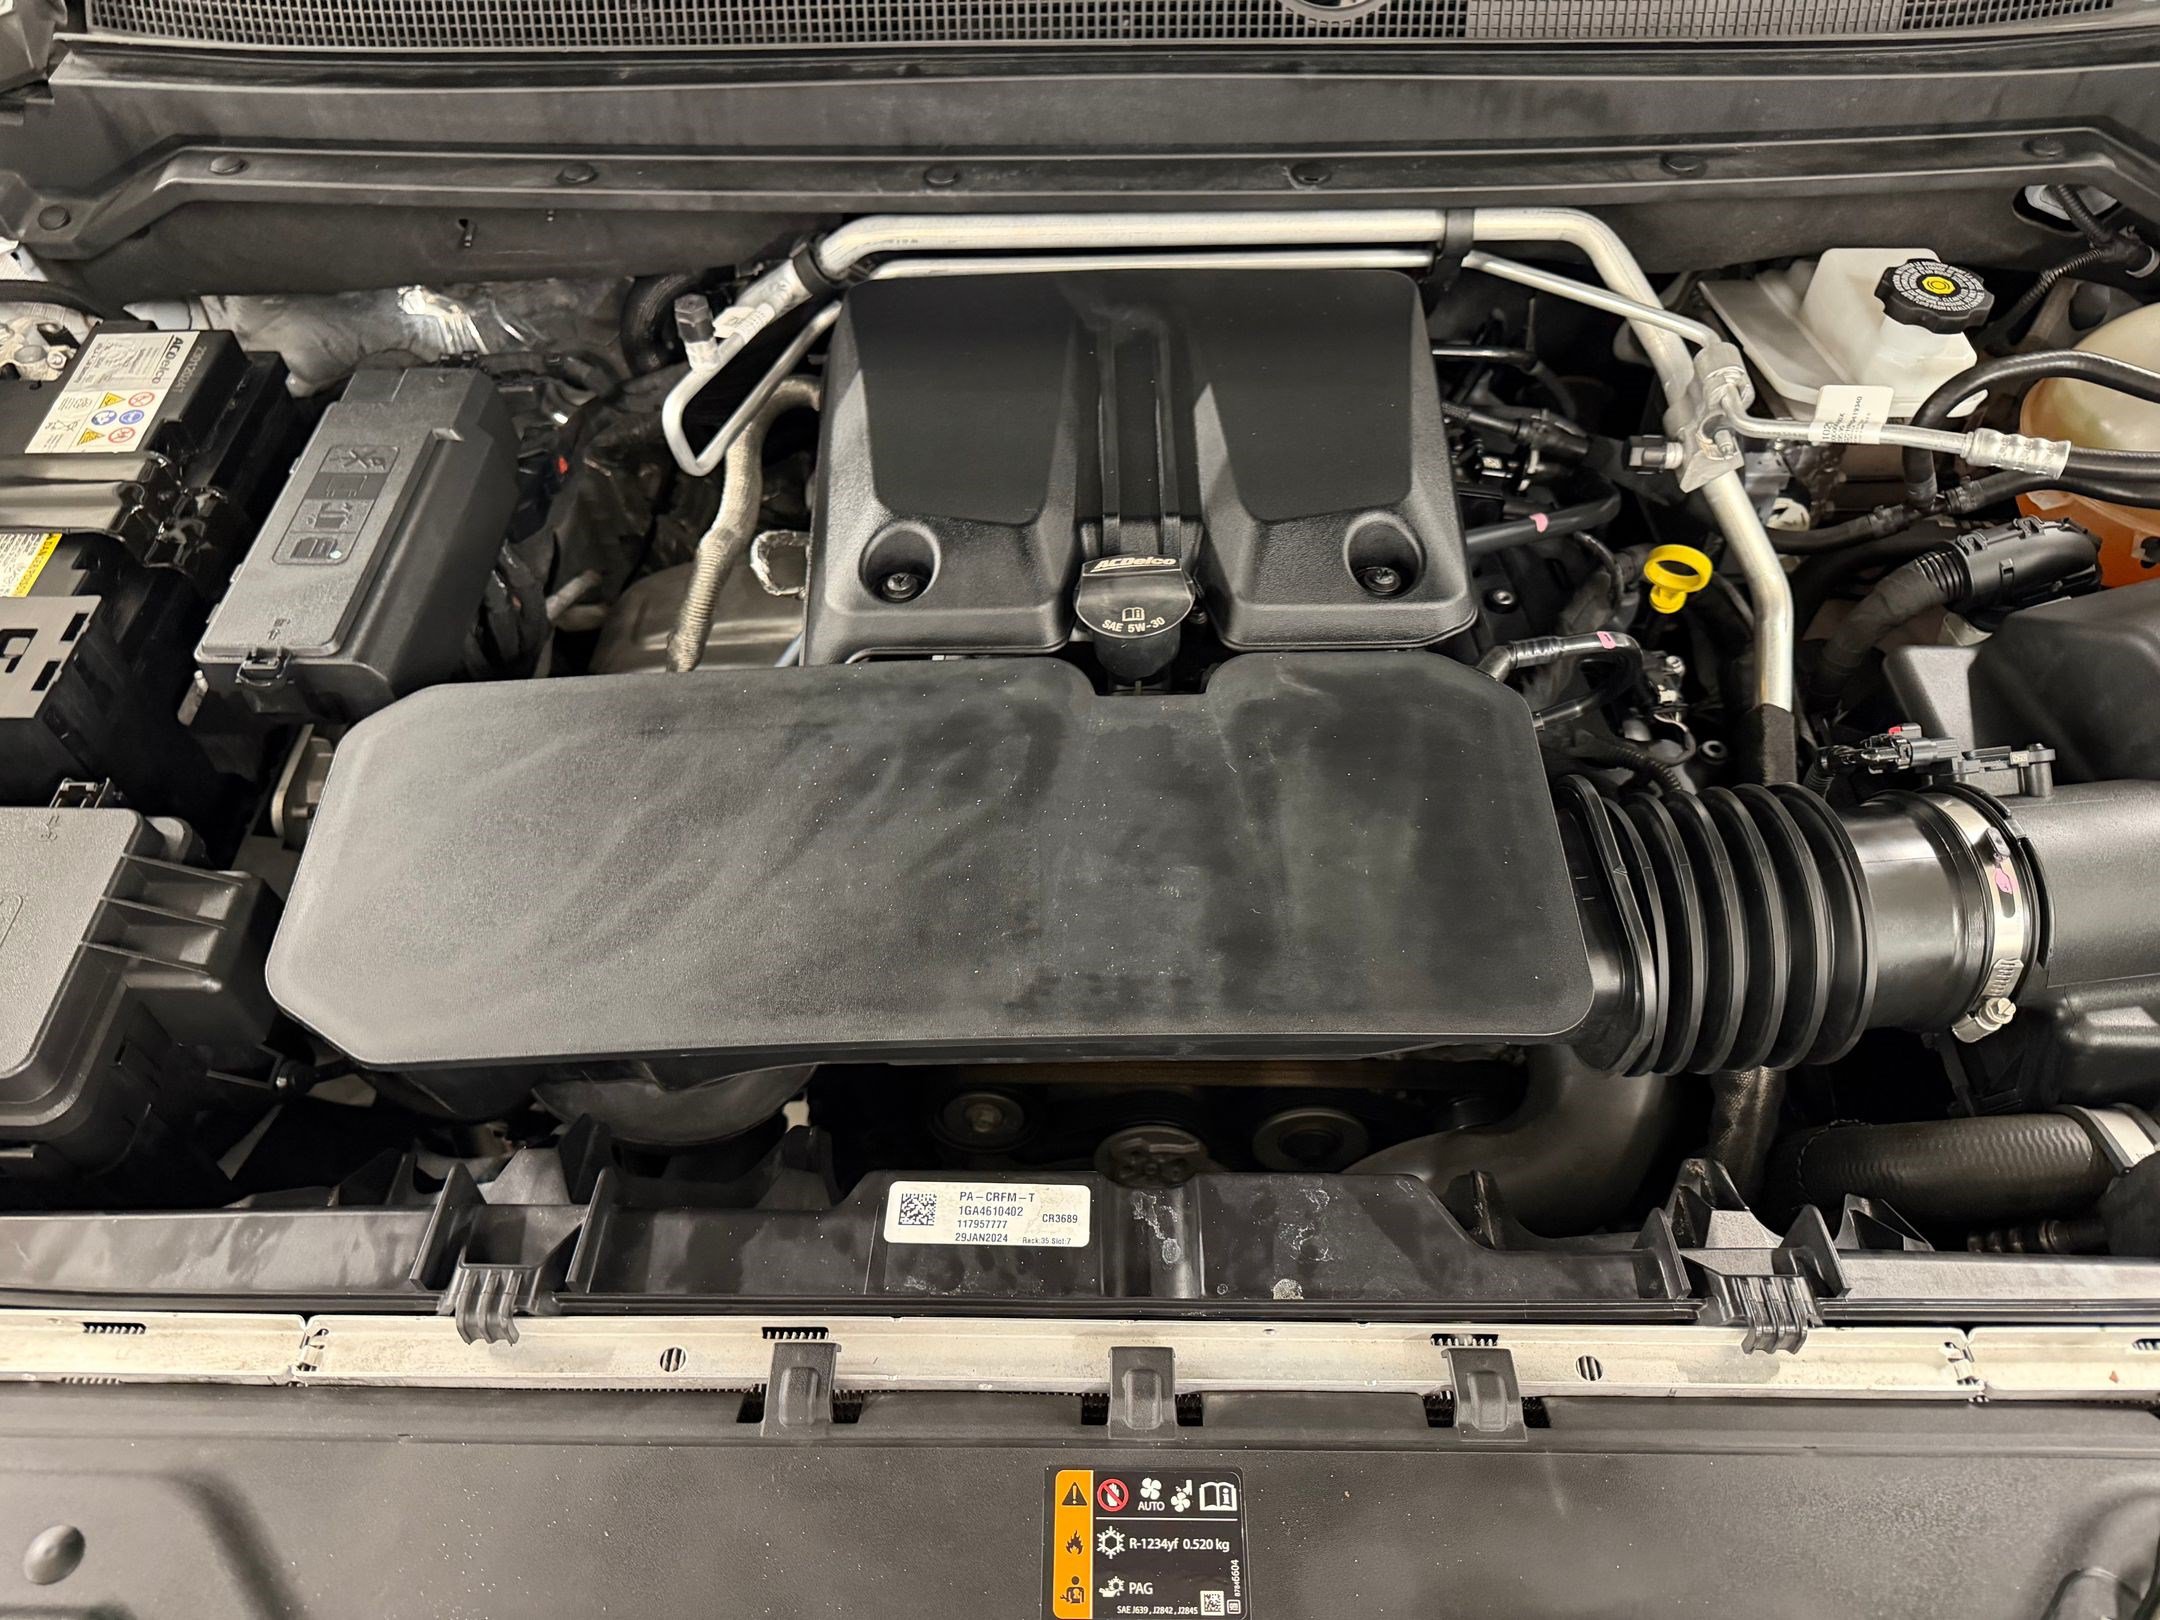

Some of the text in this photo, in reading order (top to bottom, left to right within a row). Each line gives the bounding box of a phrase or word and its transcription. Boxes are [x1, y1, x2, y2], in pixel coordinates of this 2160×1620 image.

[152, 336, 184, 384] ACDelco
[1093, 556, 1177, 569] ACDelco
[1102, 616, 1166, 633] SAE 5W-30
[958, 1206, 1024, 1217] 1GA4610402
[957, 1219, 1007, 1229] 117957777
[1042, 1213, 1078, 1224] CR3689
[955, 1232, 1008, 1243] 29JAN2024
[1137, 1501, 1165, 1511] AUTO
[1129, 1537, 1230, 1552] R-1234yf 0.520 kg
[1128, 1583, 1154, 1595] PAG
[1116, 1605, 1131, 1614] SAE
[1177, 1606, 1198, 1615] J2845
